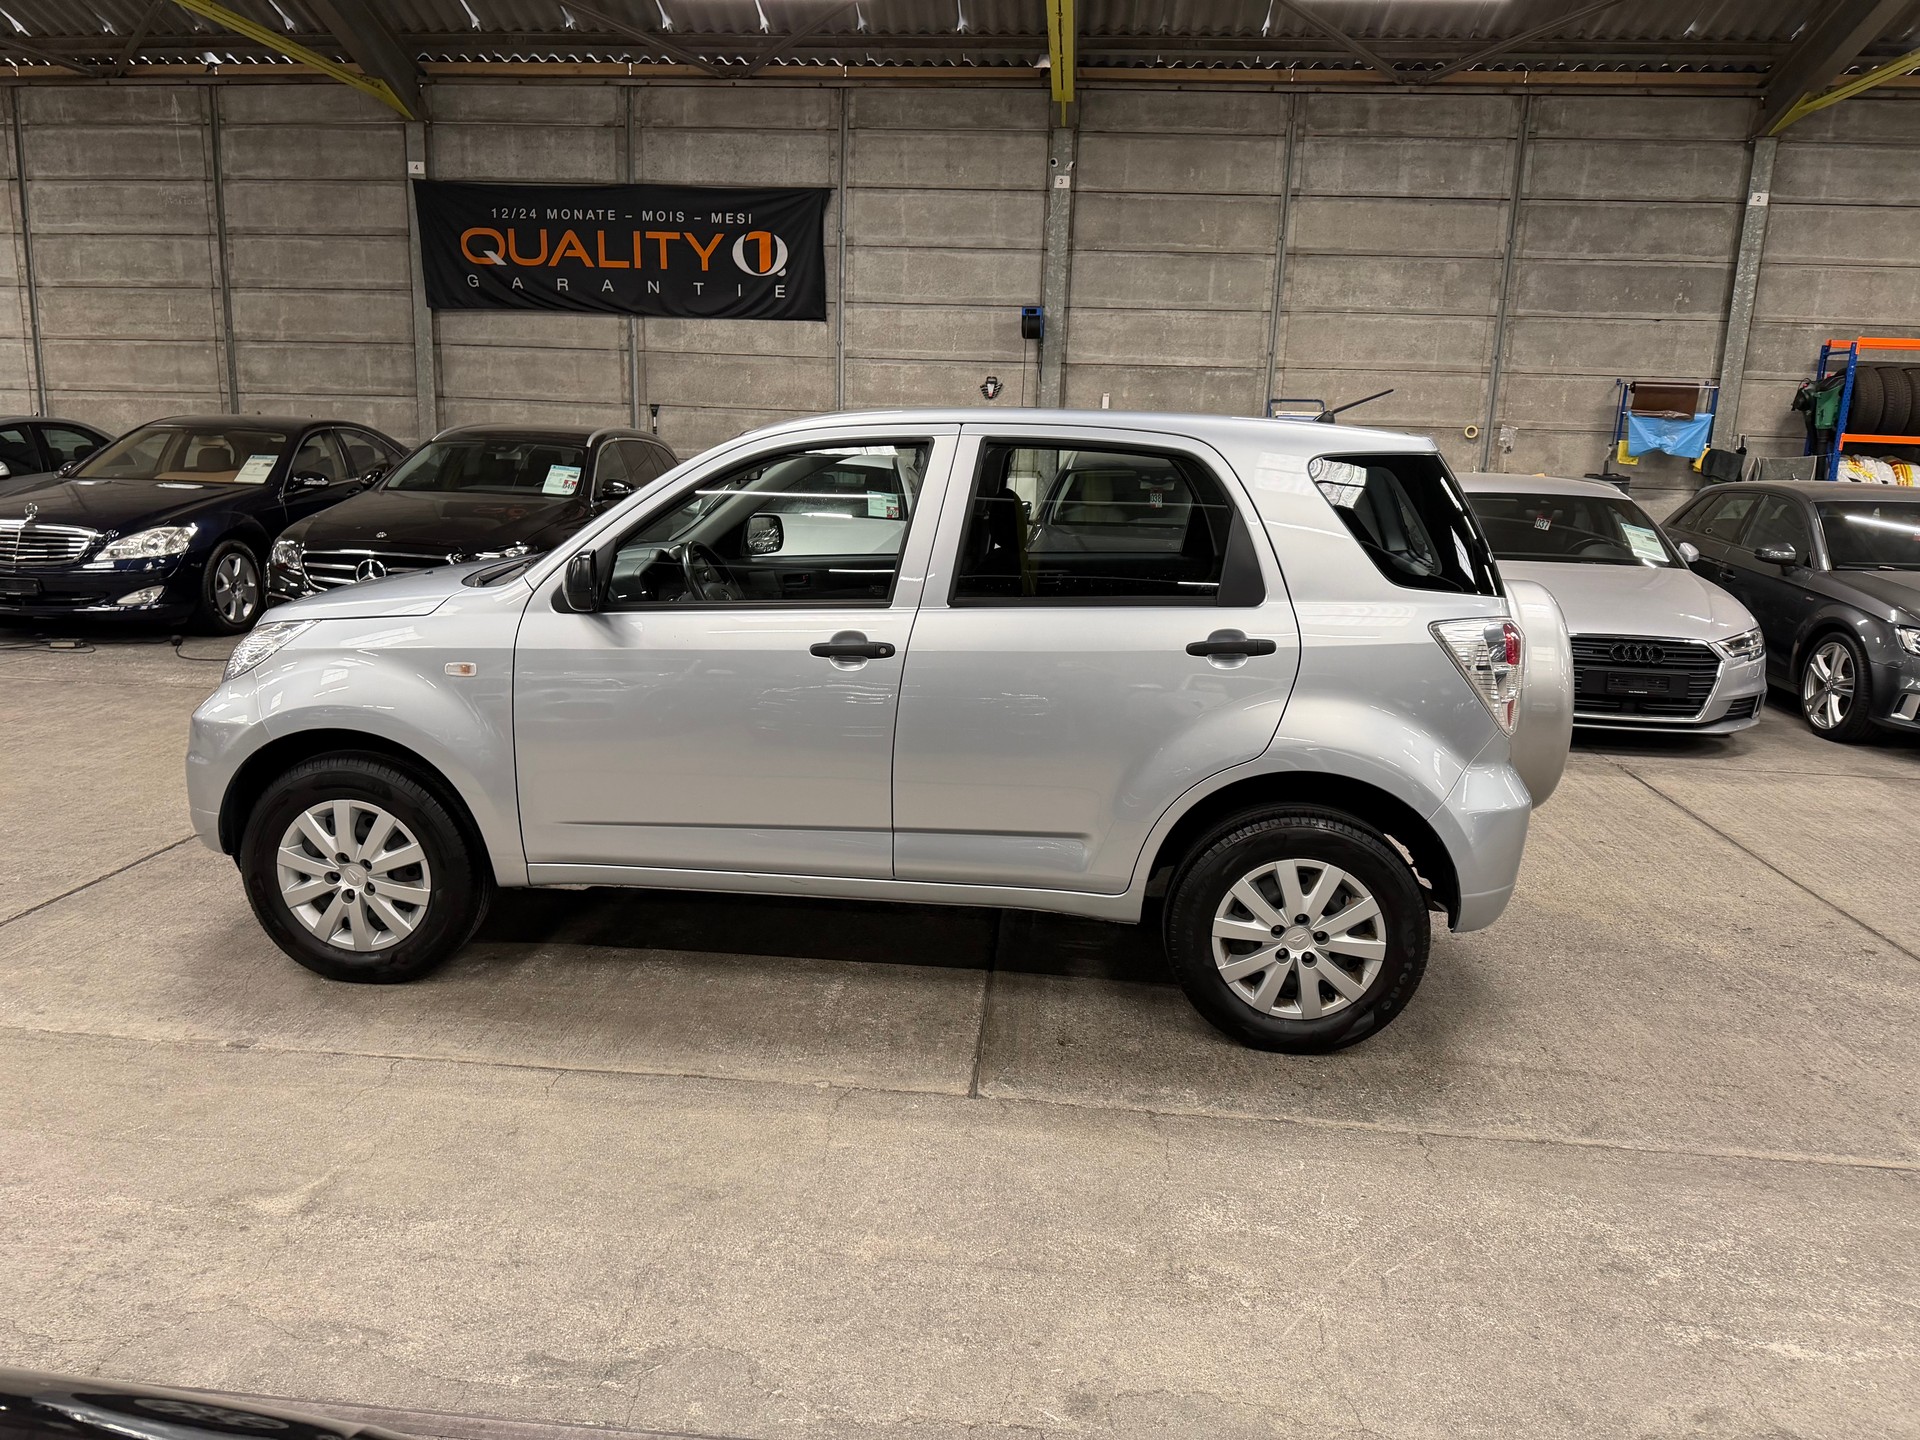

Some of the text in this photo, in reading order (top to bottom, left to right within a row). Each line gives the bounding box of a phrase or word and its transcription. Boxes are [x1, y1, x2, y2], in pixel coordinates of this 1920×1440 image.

[491, 208, 537, 219] 12/24
[546, 208, 616, 221] MONATE
[642, 210, 685, 223] MOIS
[711, 212, 752, 225] MESI
[460, 227, 725, 272] QUALITY
[467, 274, 786, 298] GARANTIE
[1535, 518, 1549, 529] 037
